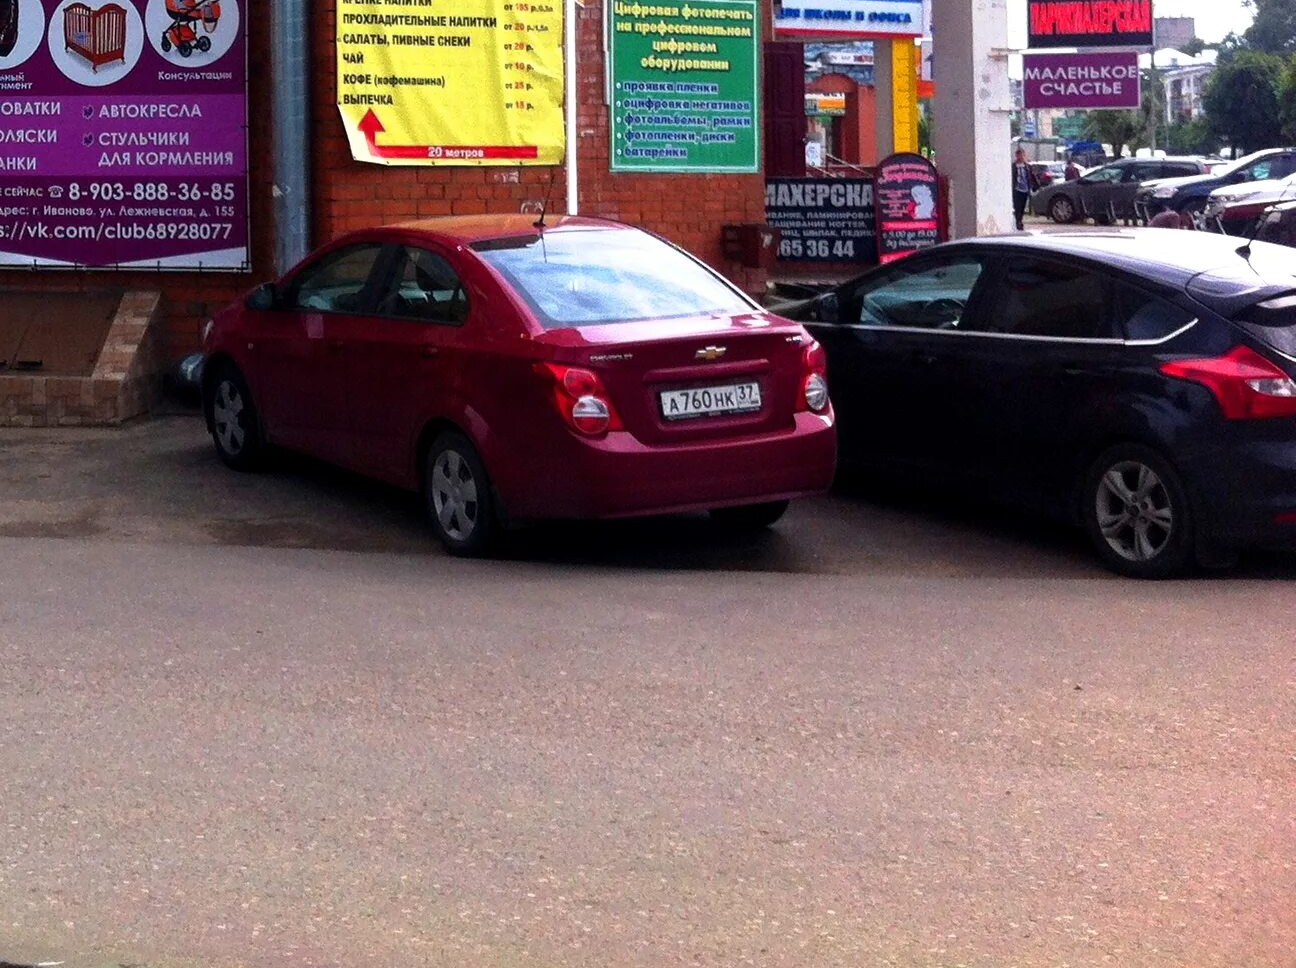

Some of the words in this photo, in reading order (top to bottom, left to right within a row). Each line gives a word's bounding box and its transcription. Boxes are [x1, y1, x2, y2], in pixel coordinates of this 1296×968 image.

[614, 1, 679, 17] Цифровая
[681, 4, 753, 20] фотопечать
[343, 13, 447, 27] ПРОХЛАДИТЕЛЬНЫЕ
[449, 17, 498, 28] НАПИТКИ
[635, 20, 751, 37] профессиональном
[343, 34, 390, 46] САЛАТЫ,
[392, 35, 435, 46] ПИВНЫЕ
[437, 36, 470, 47] СНЕКИ
[652, 38, 717, 54] цифровом
[343, 52, 364, 64] ЧАЙ
[158, 70, 232, 82] Консультации
[1025, 66, 1137, 81] МАЛЕНЬКОЕ
[343, 74, 372, 85] КОФЕ
[374, 75, 446, 89] (кофемашина)
[1040, 82, 1122, 96] СЧАСТЬЕ
[343, 94, 394, 105] ВЫПЕЧКА
[99, 104, 202, 118] АВТОКРЕСЛА
[99, 132, 190, 146] СТУЛЬЧИКИ
[98, 152, 133, 167] ДЛЯ
[136, 151, 233, 166] КОРМЛЕНИЯ
[427, 147, 443, 157] 20
[445, 148, 484, 159] метров
[68, 183, 235, 201] 8-903-888-36-85
[215, 205, 234, 216] 155
[777, 240, 803, 257] 65
[806, 240, 828, 257] 36
[833, 240, 855, 257] 44
[669, 390, 735, 412] А760НК
[738, 385, 754, 399] 37
